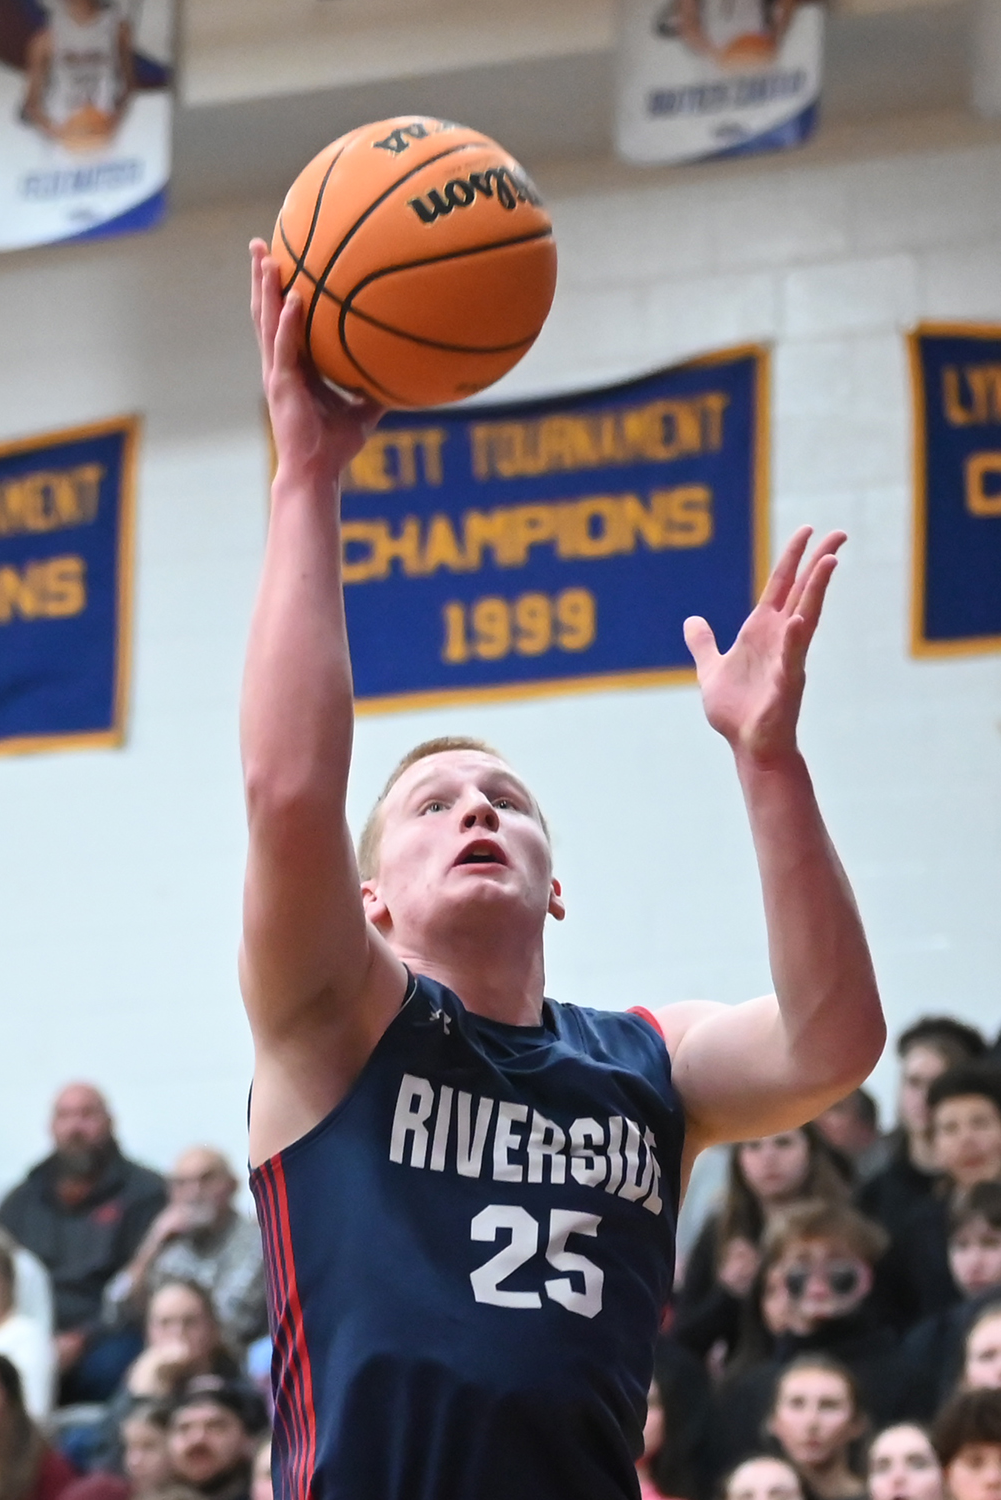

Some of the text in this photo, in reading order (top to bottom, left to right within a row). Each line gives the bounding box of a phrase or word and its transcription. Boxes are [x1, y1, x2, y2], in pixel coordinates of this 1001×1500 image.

[470, 392, 729, 482] TOURNAMENT
[342, 486, 713, 583] CHAMPIONS
[442, 587, 596, 664] 1999
[389, 1073, 663, 1215] RIVERSIDE
[470, 1204, 604, 1319] 25
